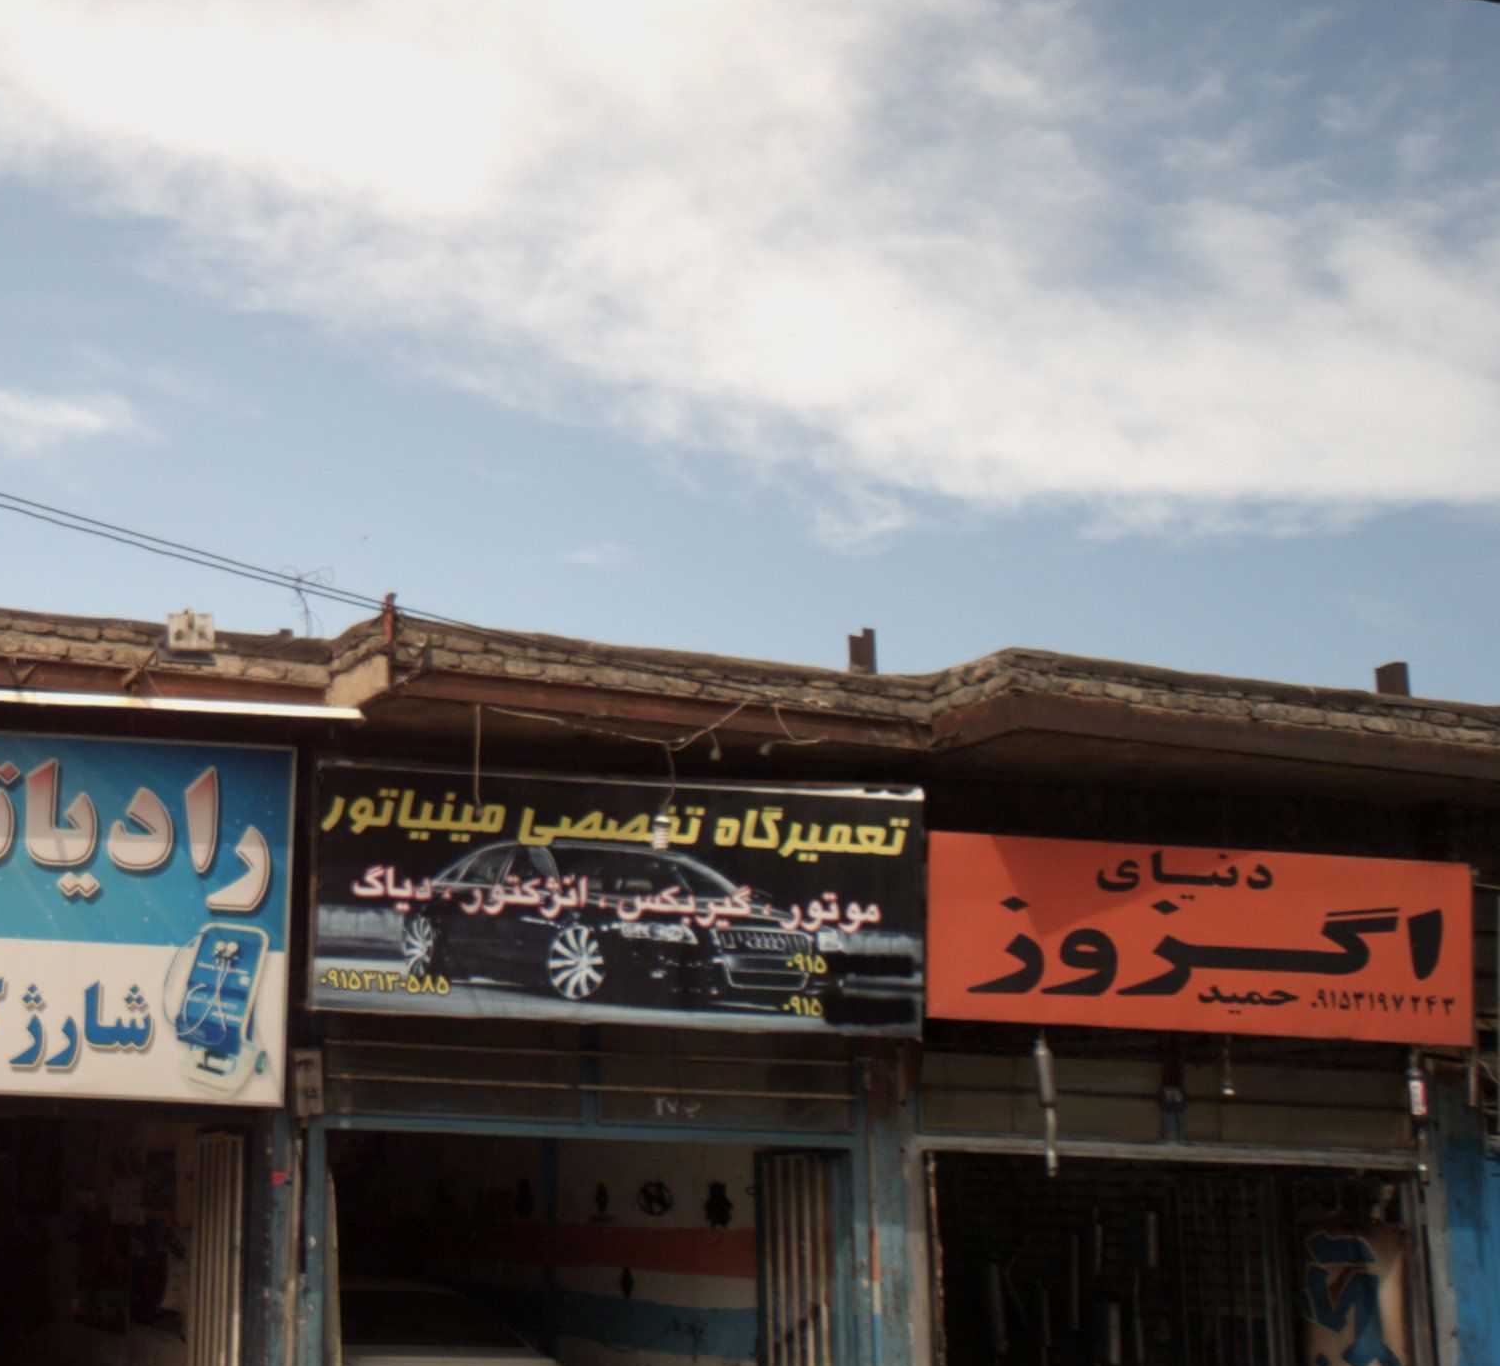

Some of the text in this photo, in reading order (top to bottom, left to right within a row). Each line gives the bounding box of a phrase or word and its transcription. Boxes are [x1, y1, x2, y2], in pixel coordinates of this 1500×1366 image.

[321, 788, 507, 842] مینیاتور
[713, 806, 911, 863] تعمیرگاه
[353, 865, 433, 912] دیاگ
[1097, 850, 1274, 900] دنیای
[967, 896, 1443, 996] اگزوز
[10, 983, 155, 1072] شارژ
[1198, 986, 1299, 1015] حمید
